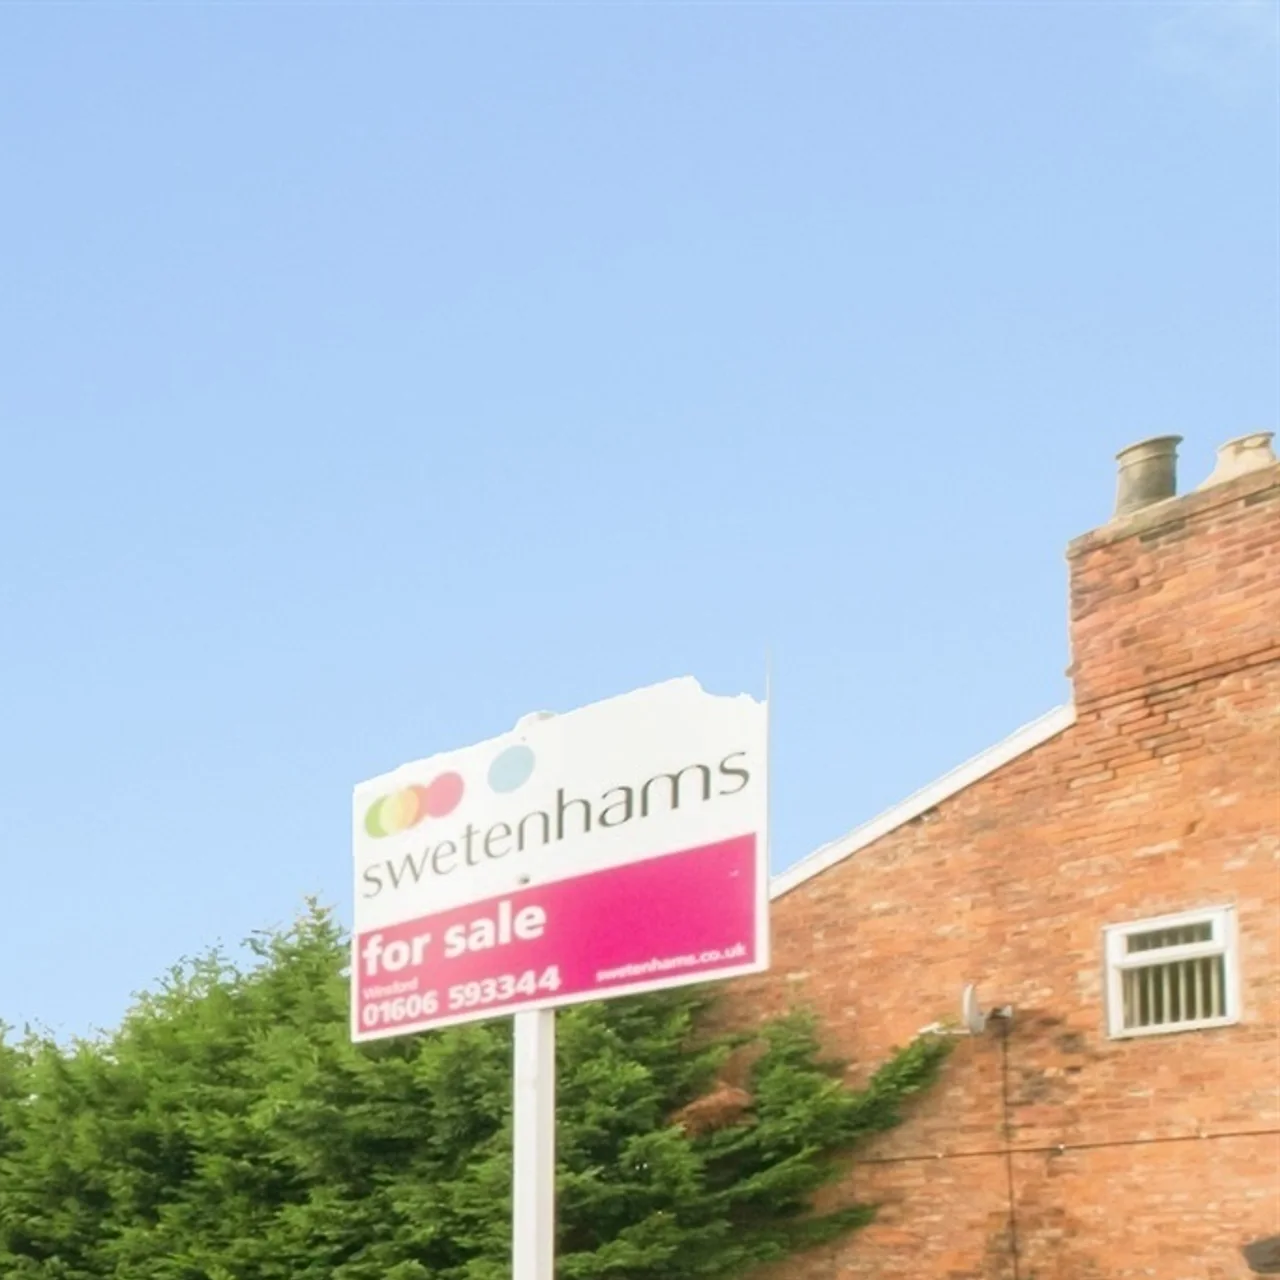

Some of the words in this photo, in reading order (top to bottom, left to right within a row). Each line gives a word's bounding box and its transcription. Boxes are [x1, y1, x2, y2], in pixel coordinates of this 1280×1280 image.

[362, 751, 751, 899] swetenhams
[362, 932, 432, 977] for
[444, 900, 547, 959] sale
[362, 990, 439, 1027] 01606
[447, 963, 561, 1011] 593344
